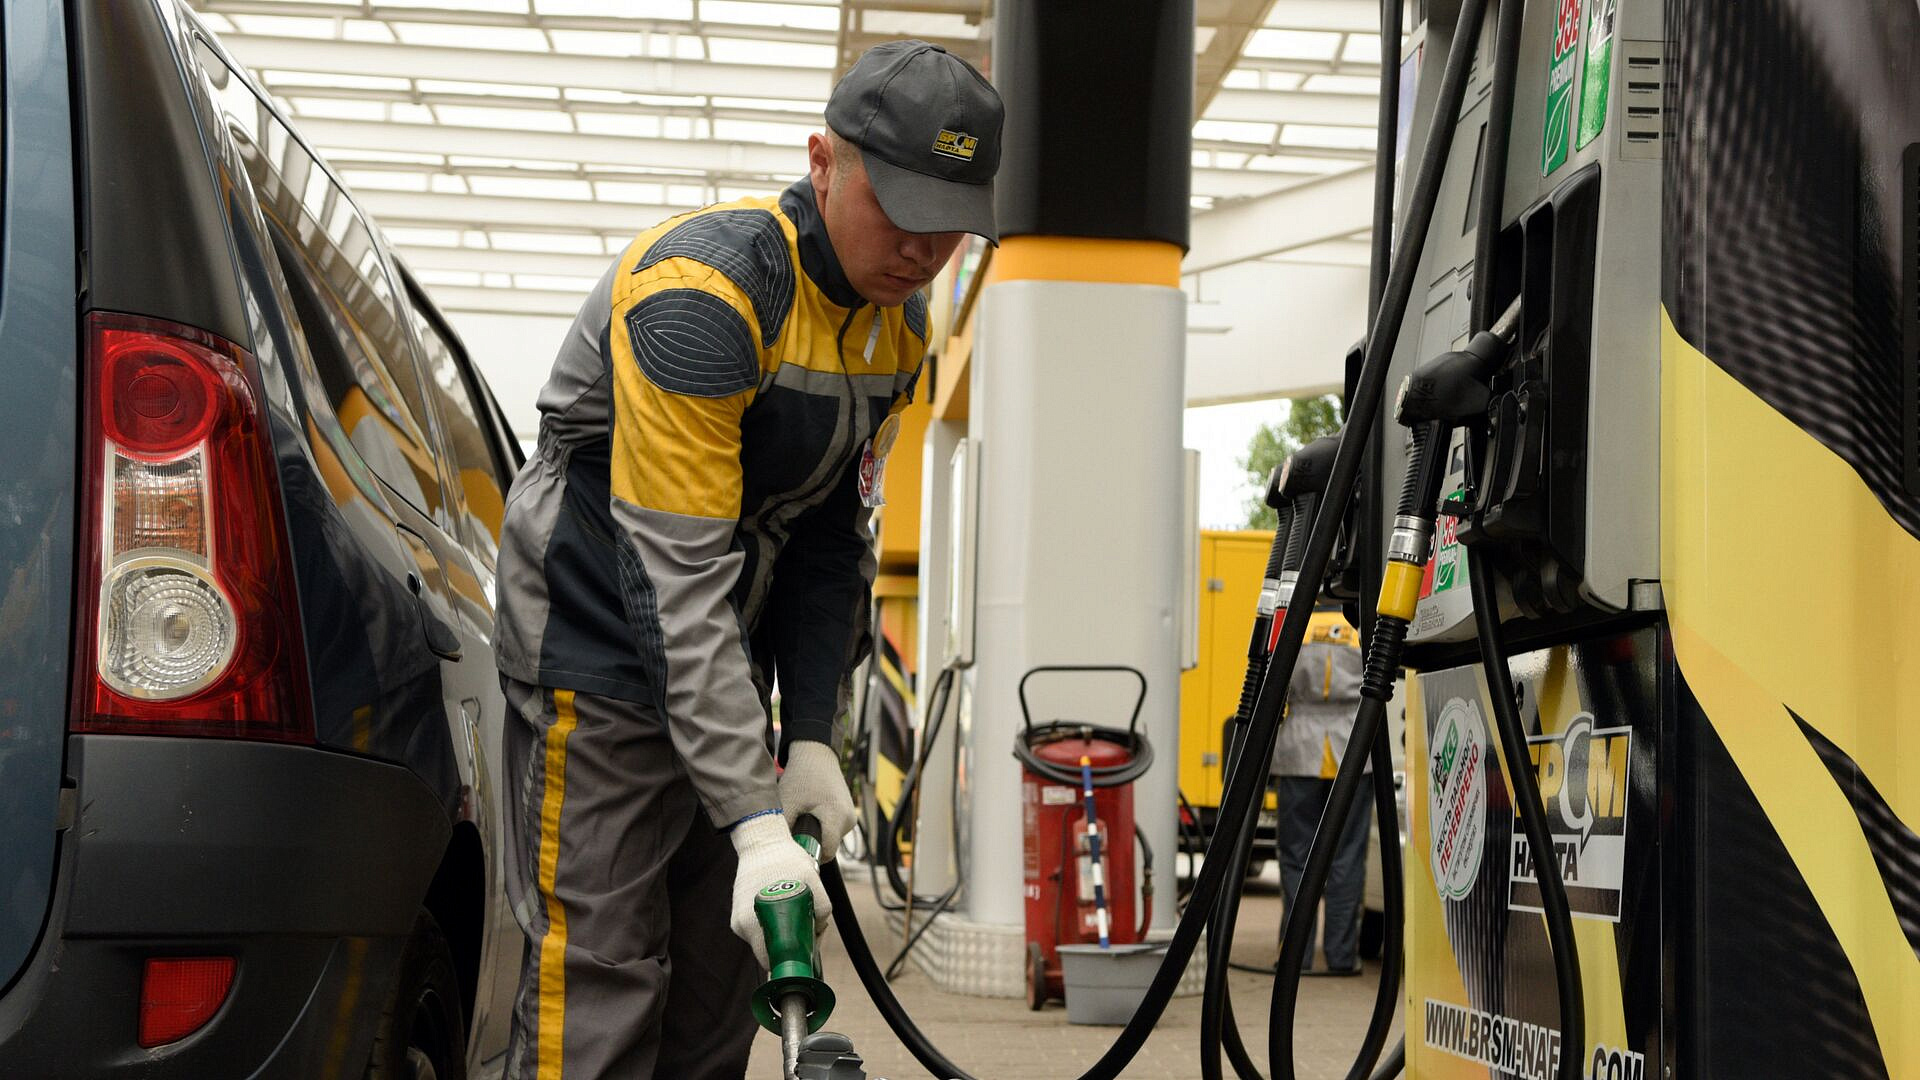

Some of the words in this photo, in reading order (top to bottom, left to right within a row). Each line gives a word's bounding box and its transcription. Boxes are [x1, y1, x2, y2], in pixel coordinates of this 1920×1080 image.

[1436, 809, 1452, 857] ЯКІСТЬ
[1450, 728, 1474, 808] ПАЛЬНОГО
[1439, 743, 1479, 876] ПЕРЕВІРЕНО
[1514, 722, 1628, 840] РСМ
[1513, 840, 1578, 881] НАТА
